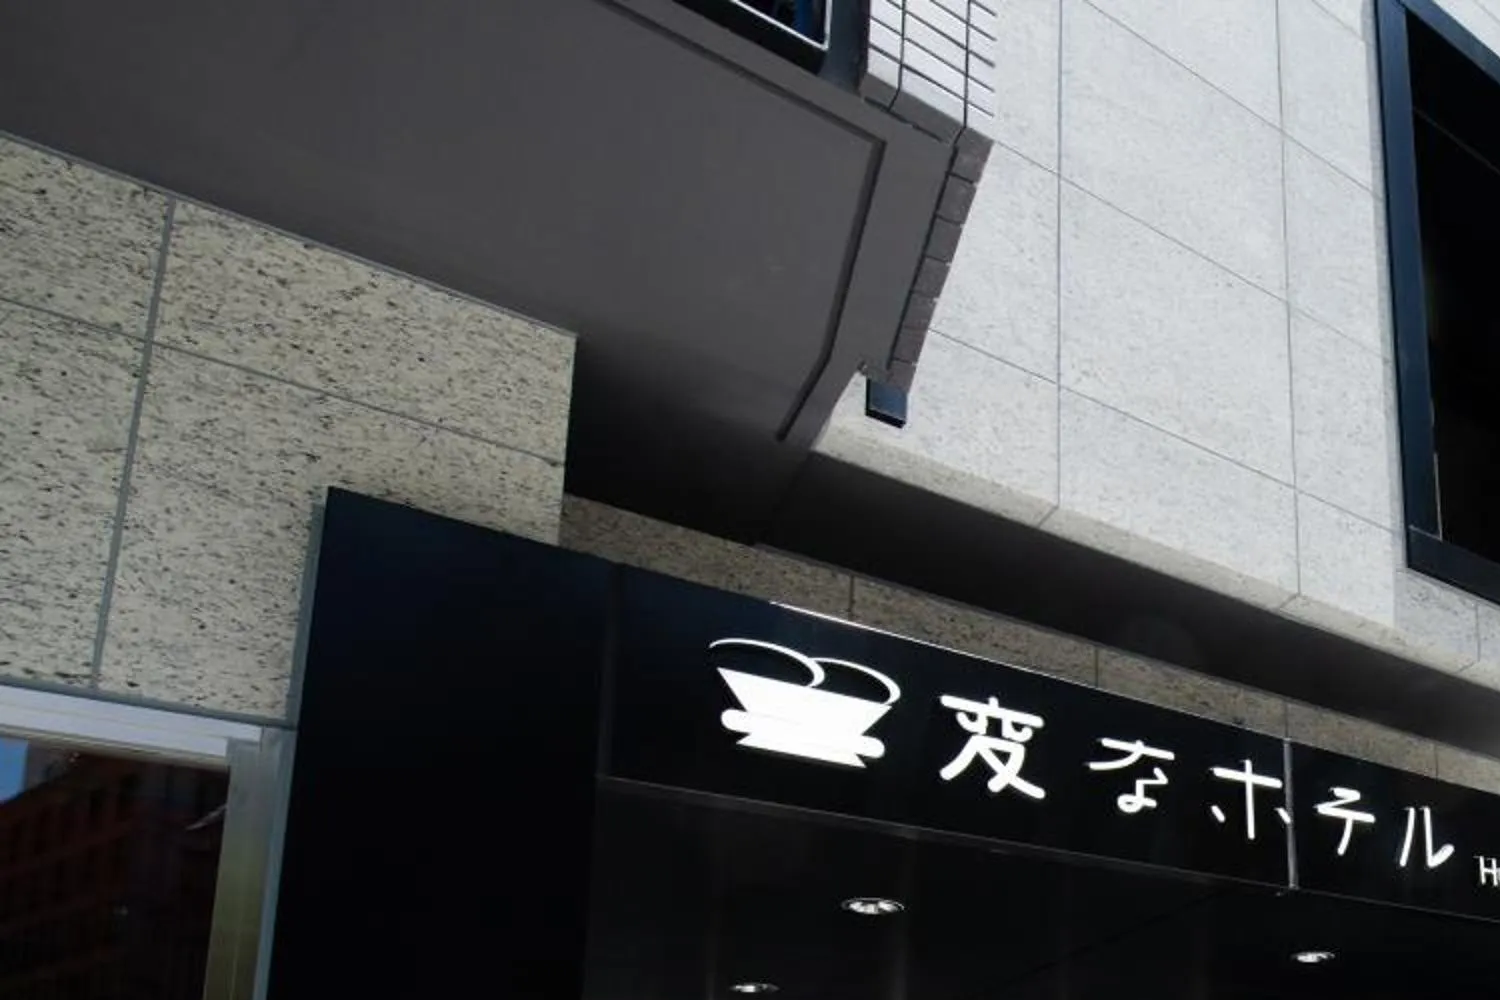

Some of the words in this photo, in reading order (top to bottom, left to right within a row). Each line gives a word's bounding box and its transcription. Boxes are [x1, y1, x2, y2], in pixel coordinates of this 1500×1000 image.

[939, 694, 1455, 869] 変なホテル
